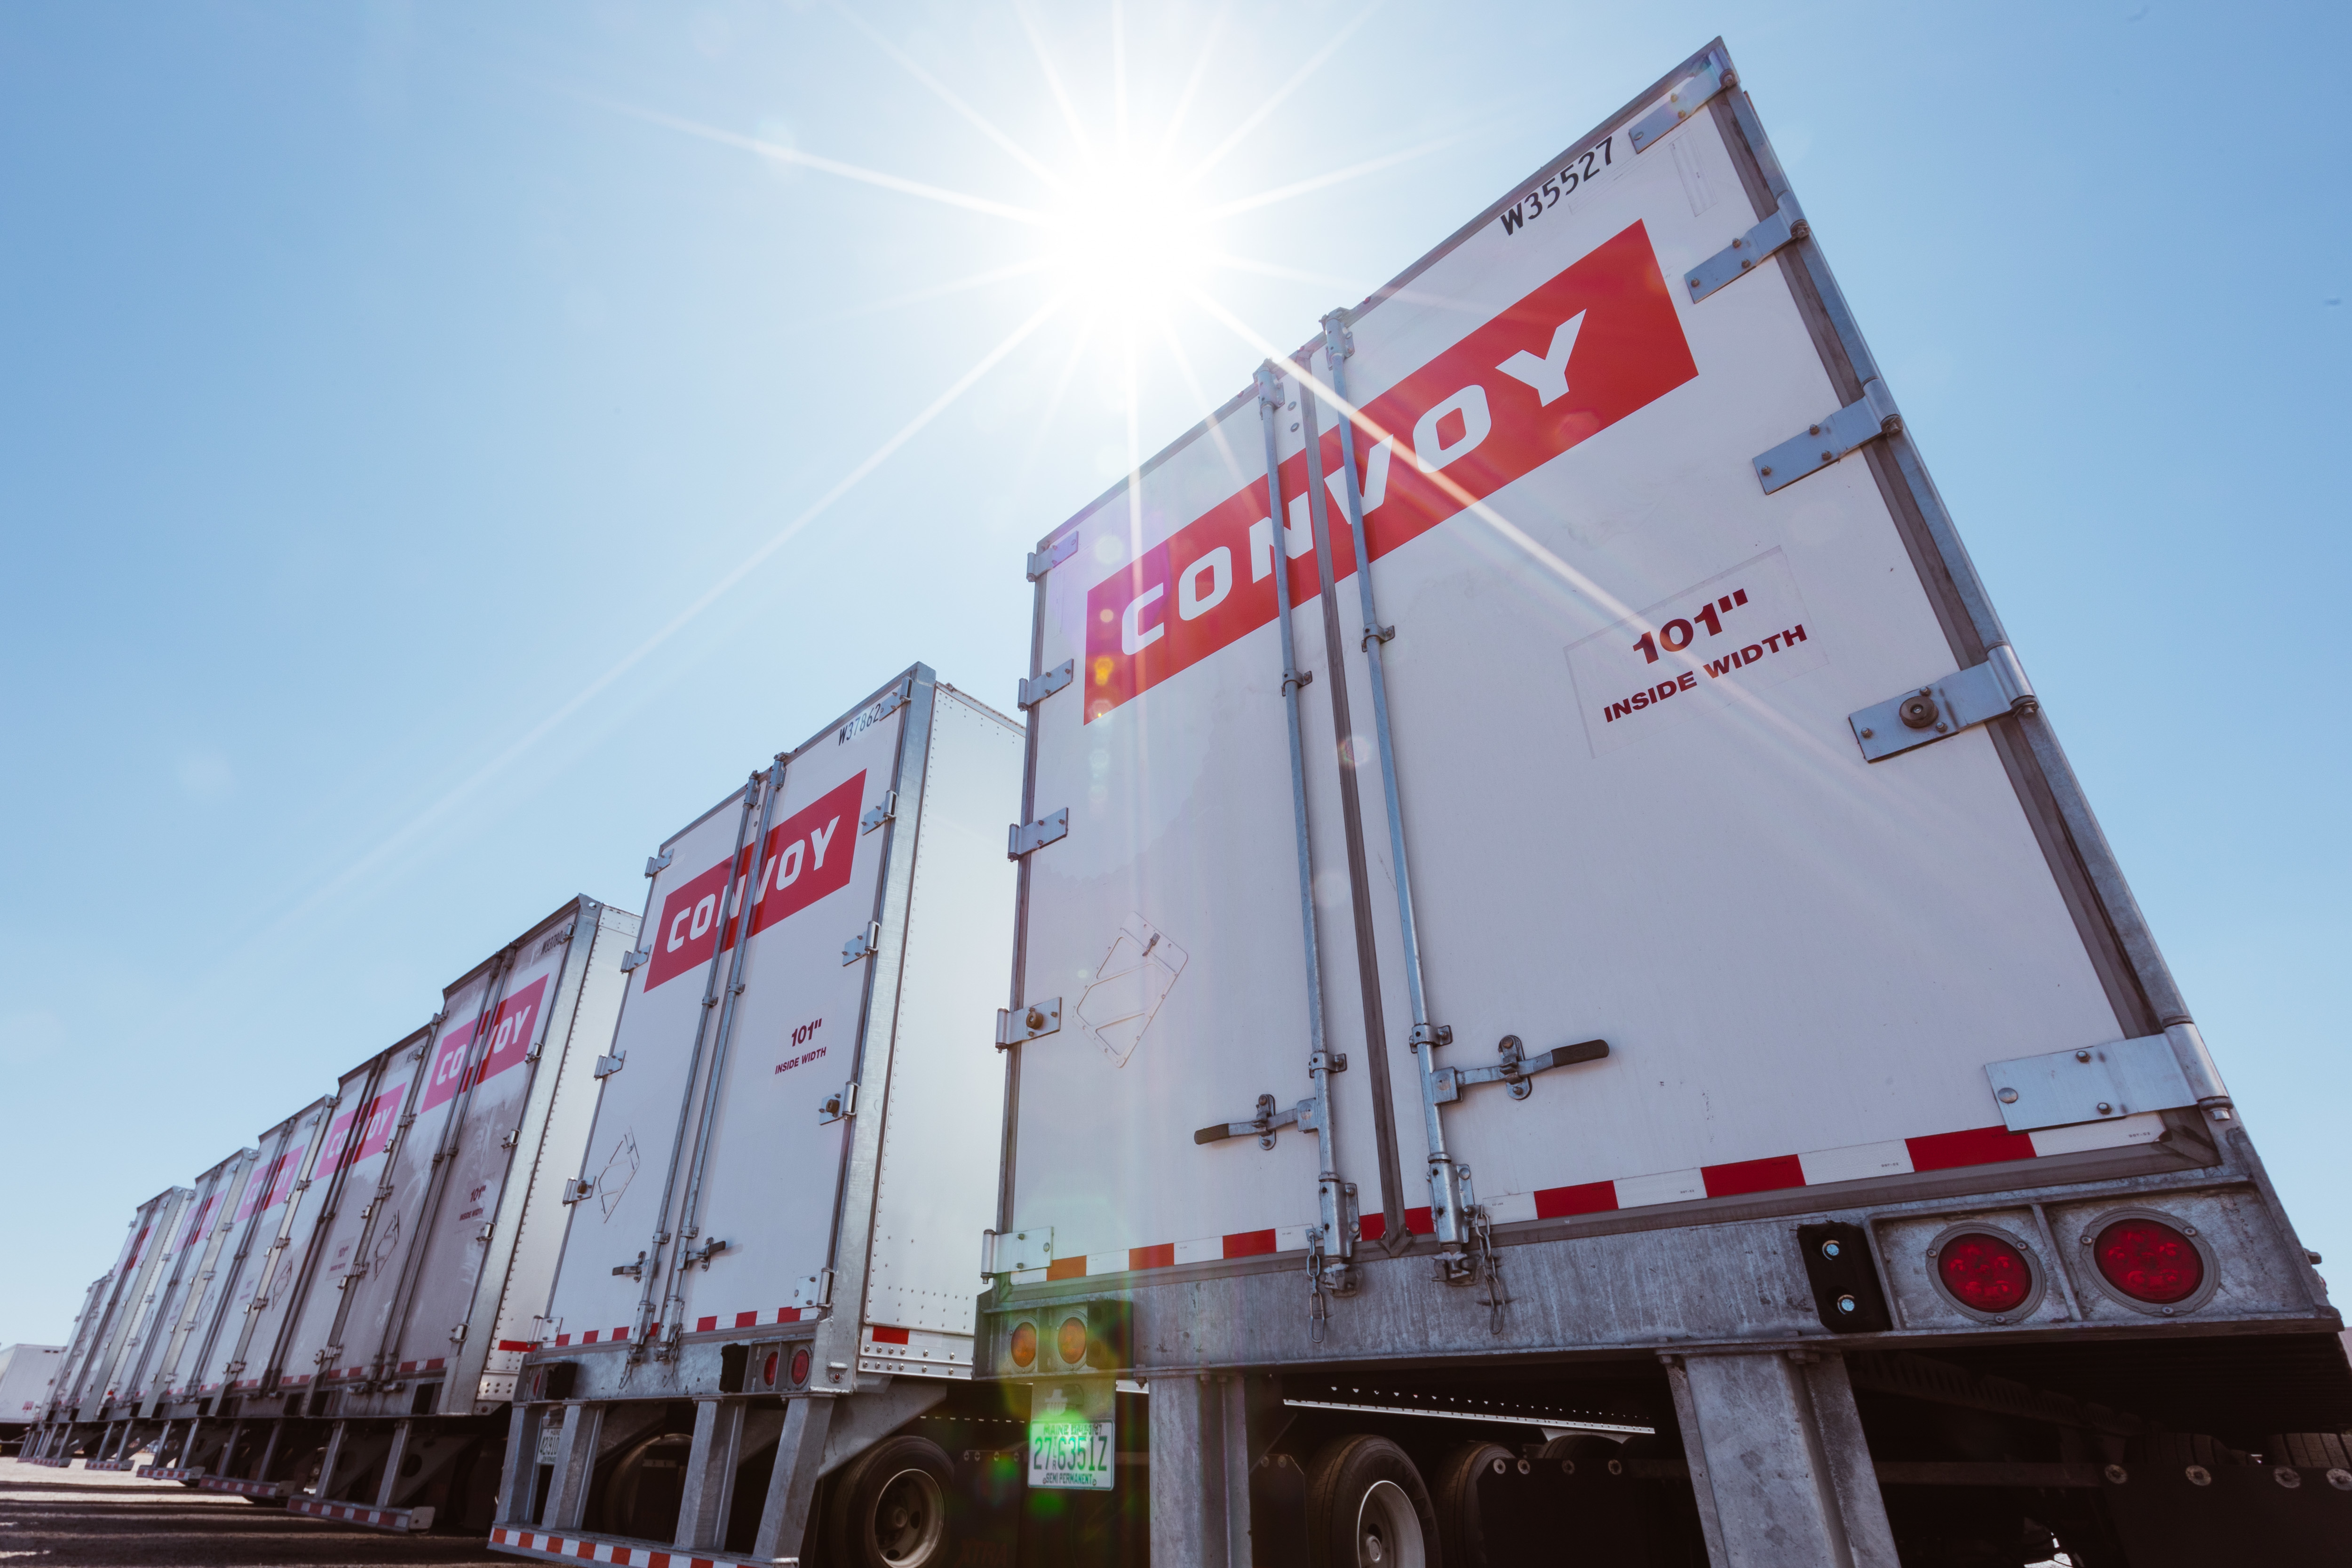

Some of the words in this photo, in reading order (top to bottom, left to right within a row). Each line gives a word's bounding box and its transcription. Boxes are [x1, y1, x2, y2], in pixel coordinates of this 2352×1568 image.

[1500, 135, 1613, 236] W35527
[1122, 309, 1587, 655] CONVOY
[1633, 588, 1748, 664] 101"
[1604, 671, 1698, 723] INSIDE
[1702, 624, 1807, 679] WIDTH
[839, 703, 881, 746] W37862
[791, 1018, 822, 1047] 101"
[775, 1057, 800, 1075] INSIDE
[801, 1046, 827, 1065] WIDTH
[1043, 1424, 1069, 1435] MAINE
[1046, 1472, 1058, 1484] SEMI
[1059, 1473, 1093, 1485] PERMANENT
